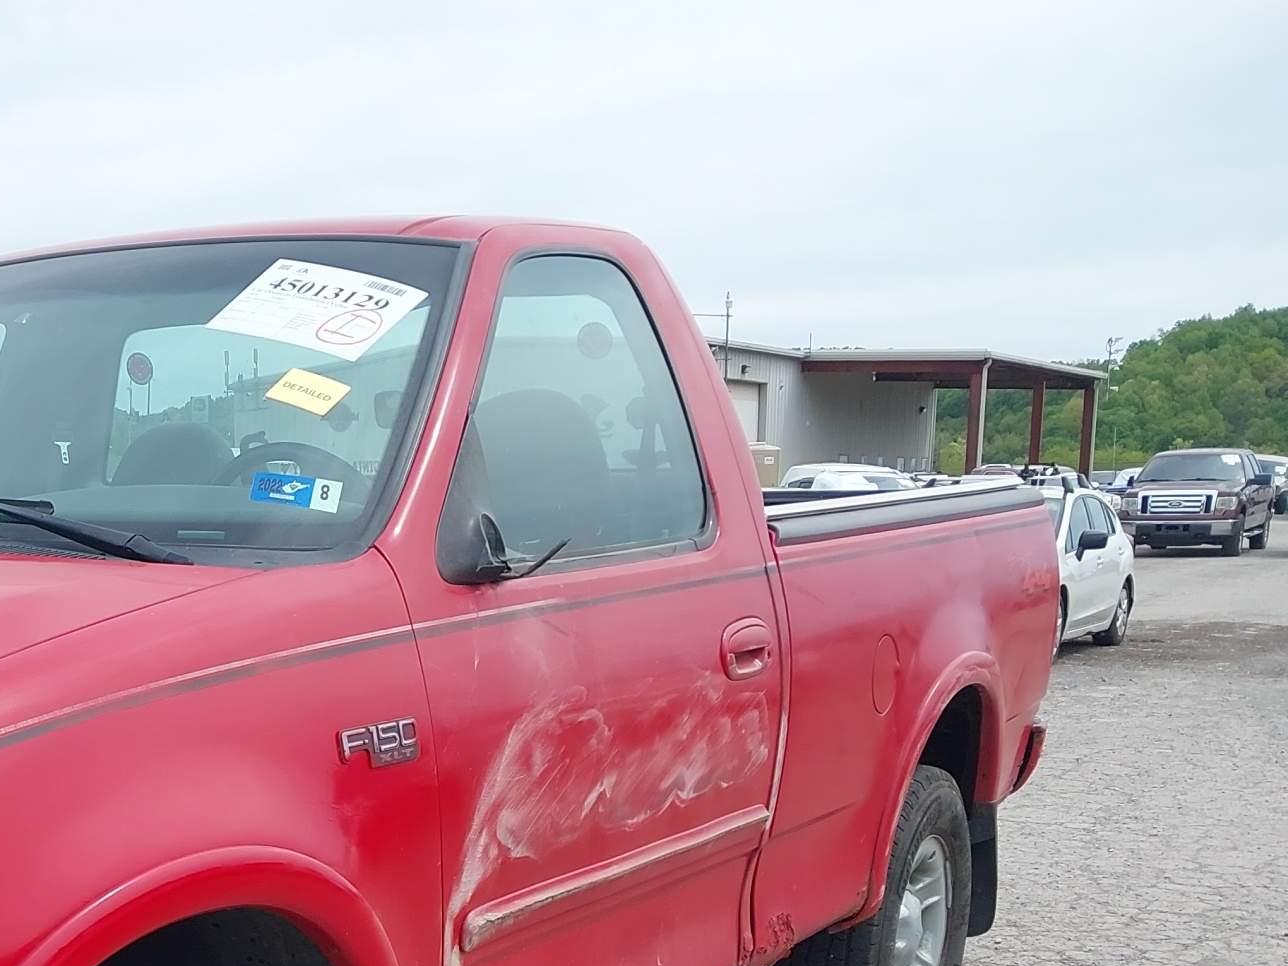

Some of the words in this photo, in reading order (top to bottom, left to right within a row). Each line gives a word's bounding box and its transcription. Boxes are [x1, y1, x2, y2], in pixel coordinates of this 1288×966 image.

[269, 277, 390, 310] 45013129
[282, 381, 332, 401] DETAILED
[320, 484, 331, 501] 8
